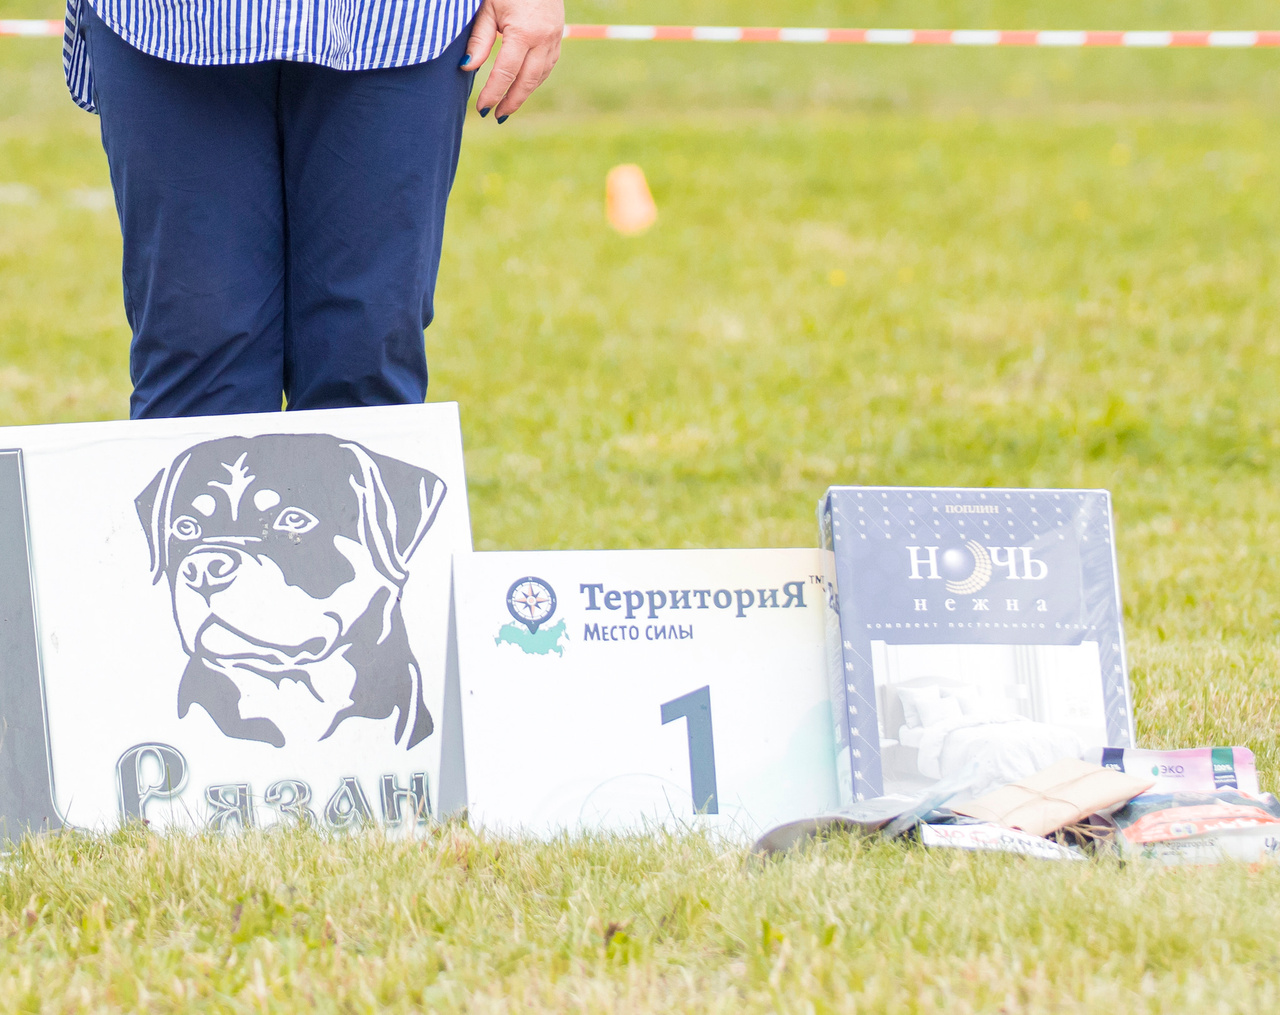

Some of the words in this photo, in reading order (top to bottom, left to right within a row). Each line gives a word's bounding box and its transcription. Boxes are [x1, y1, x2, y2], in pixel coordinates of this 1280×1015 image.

[579, 581, 808, 619] ТерриториЯ
[913, 598, 1049, 612] нежна
[660, 684, 719, 815] 1
[116, 741, 433, 834] Рязан
[1161, 765, 1185, 774] ЭКО
